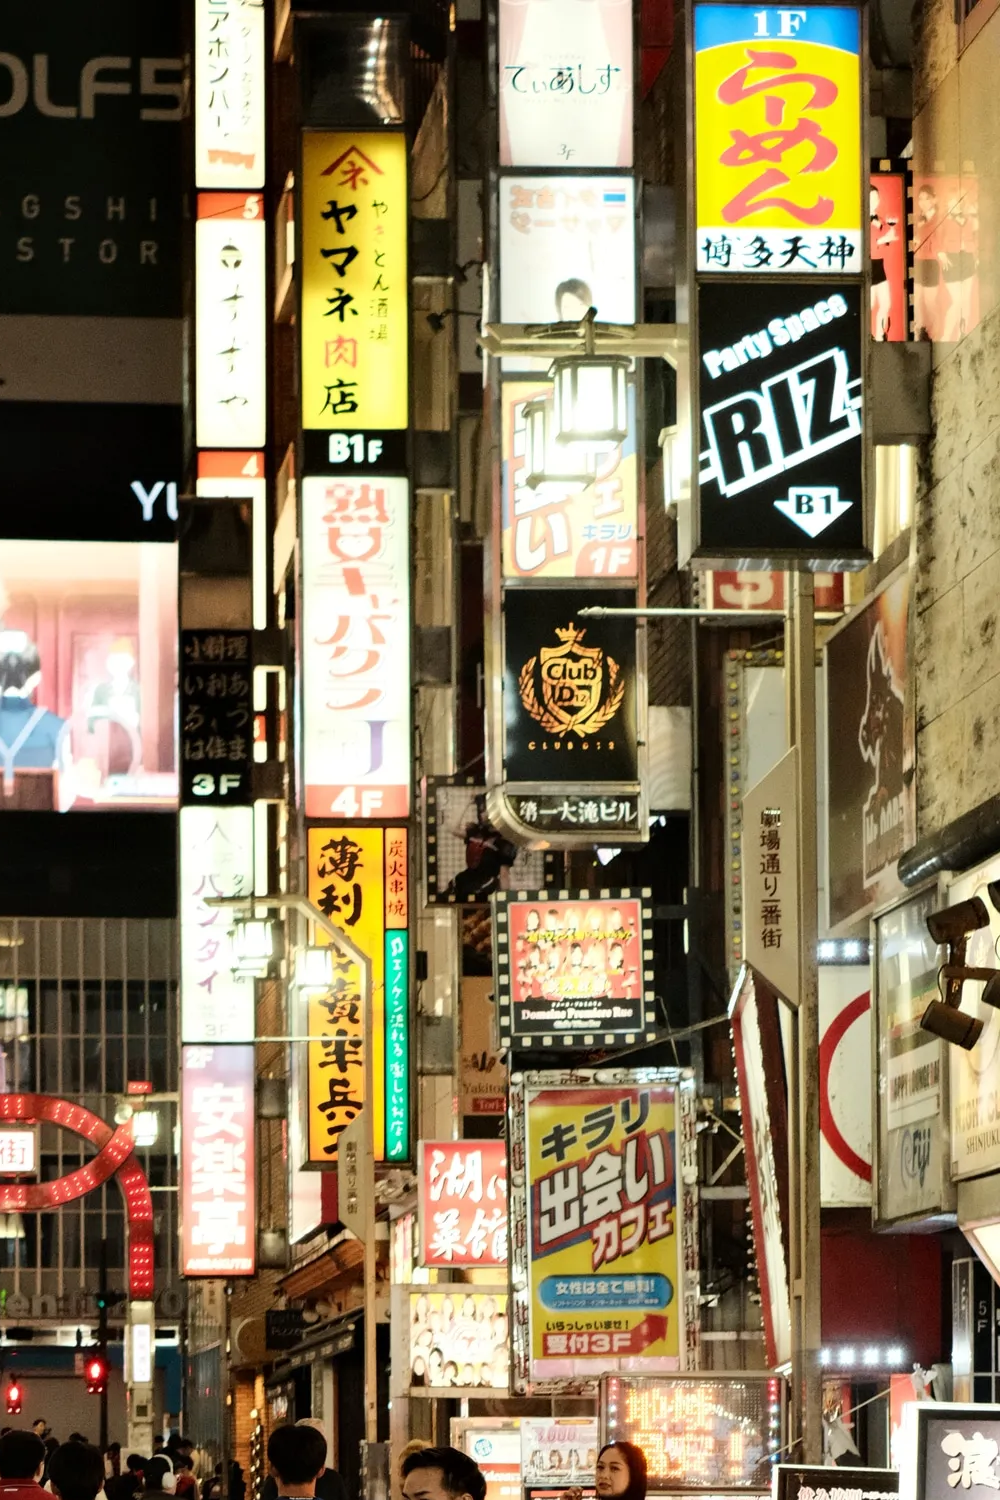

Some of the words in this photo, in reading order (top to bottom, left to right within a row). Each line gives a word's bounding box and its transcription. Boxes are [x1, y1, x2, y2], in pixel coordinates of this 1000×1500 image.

[753, 10, 806, 37] 1F
[702, 234, 855, 270] 博多天神
[319, 200, 360, 415] ヤマネ肉店
[703, 327, 773, 380] Party
[766, 293, 849, 345] Space
[703, 347, 853, 497] RIZ
[329, 433, 383, 464] B1F
[794, 494, 834, 516] B1
[582, 524, 632, 541] キラリ
[590, 547, 633, 575] 1F
[547, 663, 597, 681] Club
[191, 773, 242, 797] 3F
[330, 786, 384, 818] 4F
[519, 801, 639, 824] 第一大滝ビル
[388, 840, 406, 917] 炭火串焼
[758, 806, 784, 951] 劇場通り一番街
[541, 1092, 650, 1163] キラリ
[191, 1083, 247, 1255] 安楽亭
[911, 1127, 932, 1189] Fiji
[536, 1131, 668, 1247] 出会い
[428, 1208, 507, 1262] 菜館
[592, 1199, 675, 1271] カフェ
[546, 1332, 632, 1355] 受付3F
